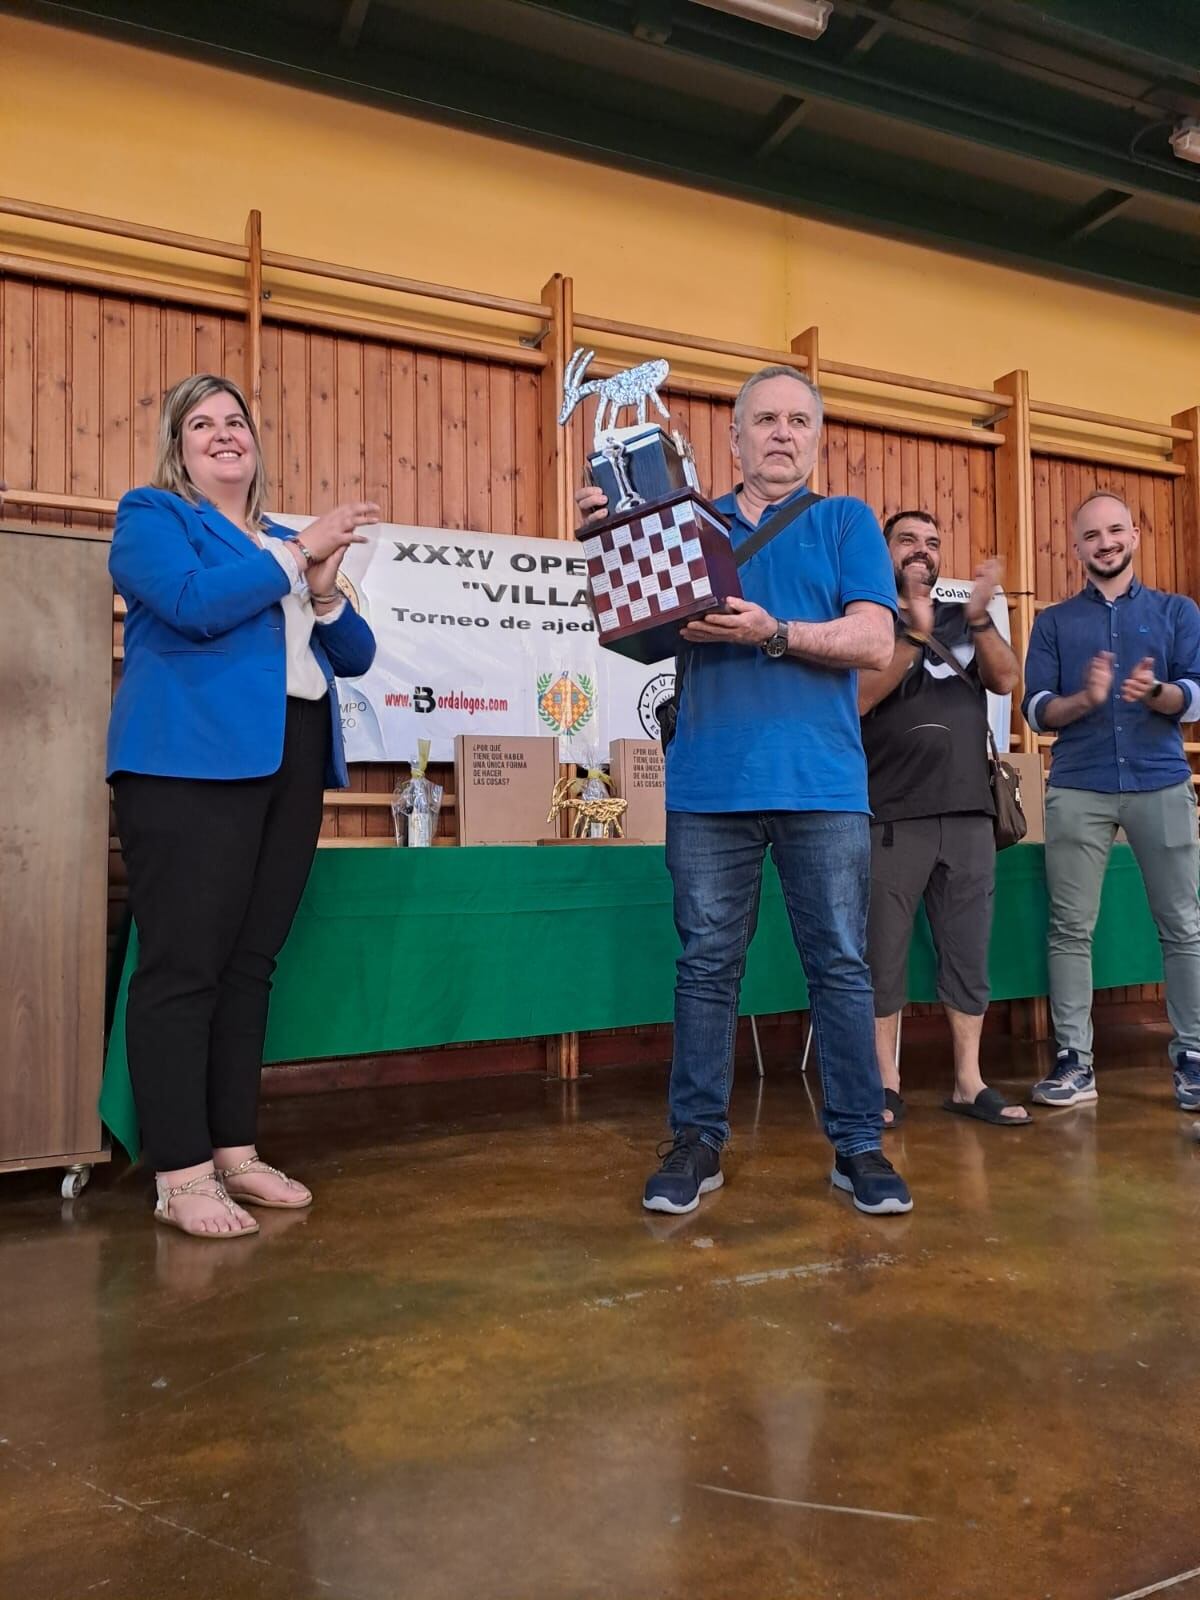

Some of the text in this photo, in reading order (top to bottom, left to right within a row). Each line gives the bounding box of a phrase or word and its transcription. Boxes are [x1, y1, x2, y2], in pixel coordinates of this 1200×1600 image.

[392, 541, 494, 570] XXXV
[391, 607, 490, 627] Torneo
[500, 616, 531, 630] de
